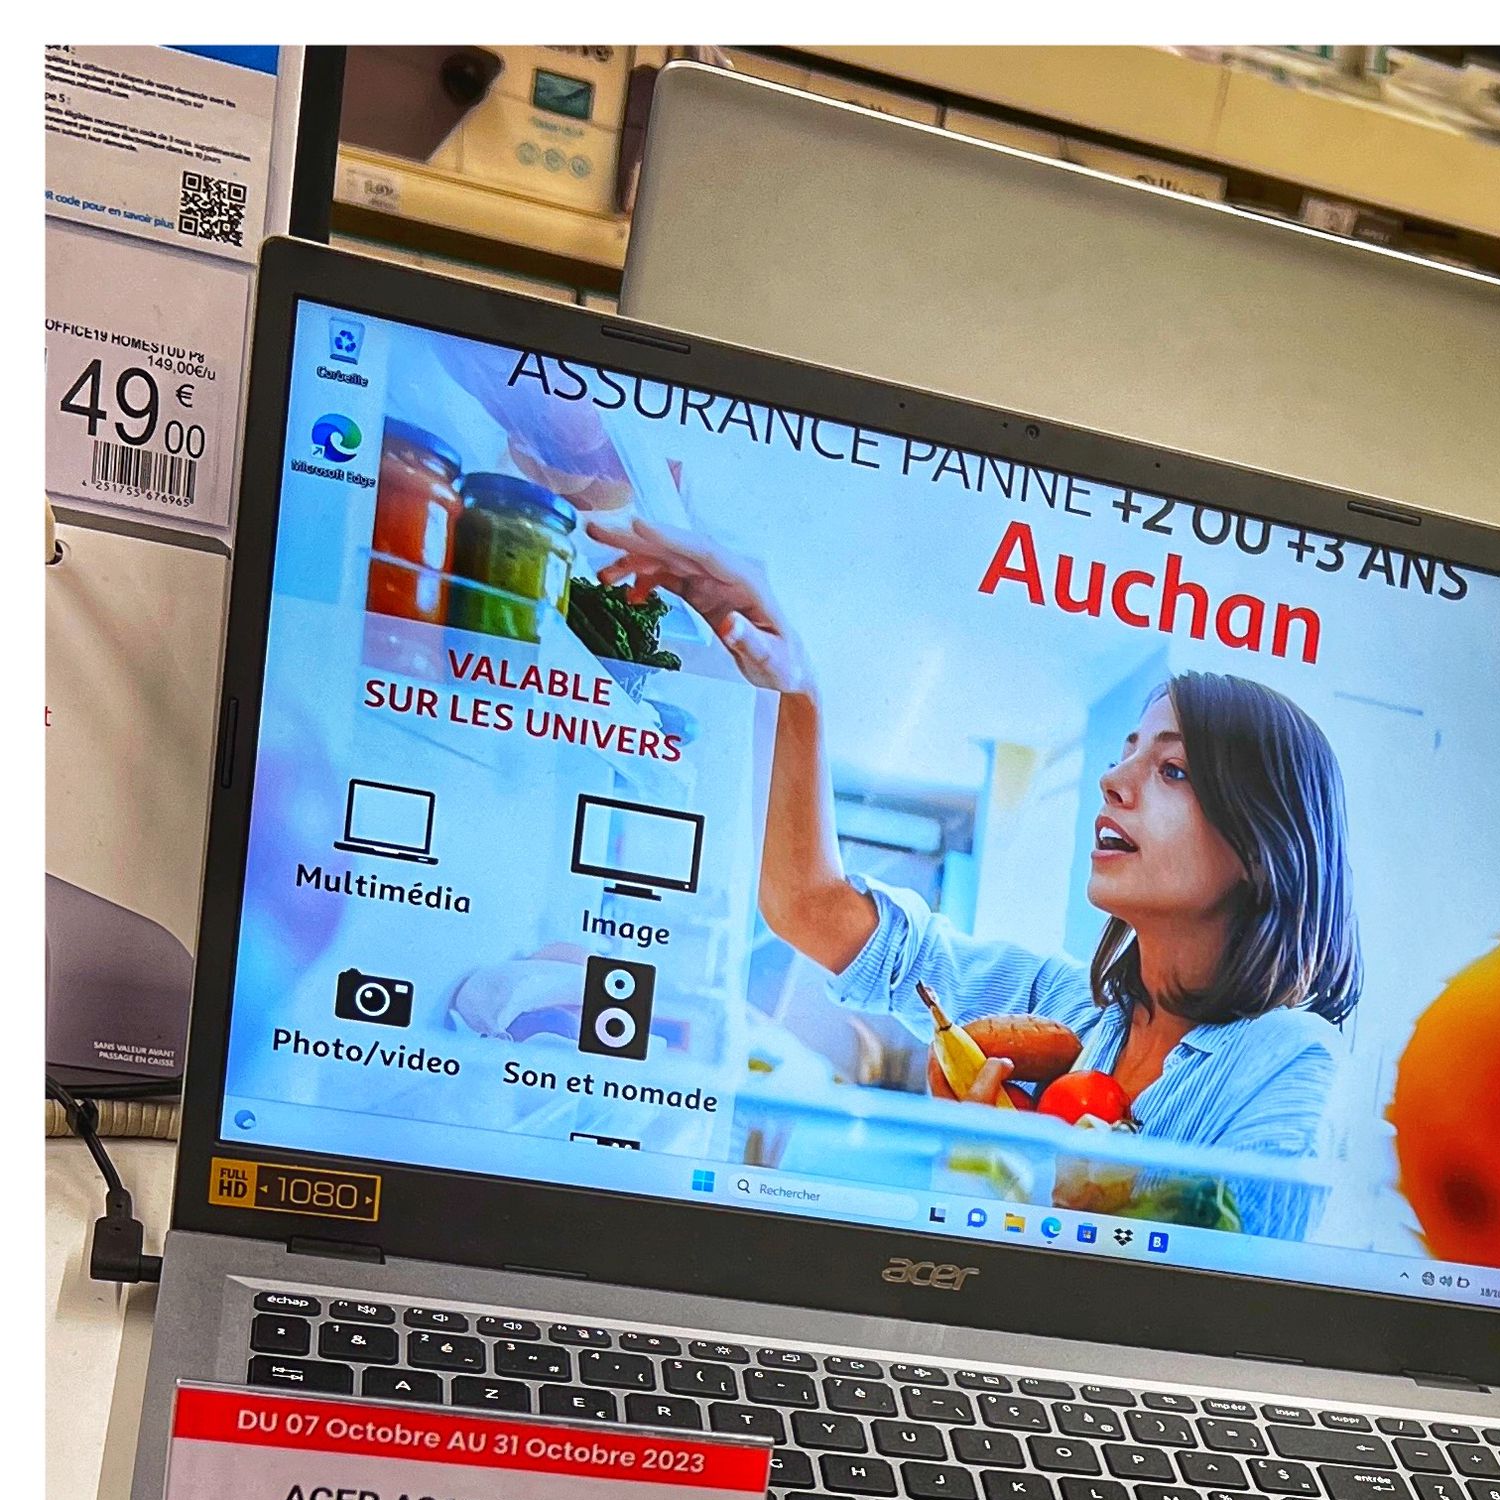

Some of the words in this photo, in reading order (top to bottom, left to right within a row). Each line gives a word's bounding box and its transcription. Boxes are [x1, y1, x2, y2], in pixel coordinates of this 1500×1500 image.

[55, 192, 81, 208] code
[82, 197, 106, 215] pour
[108, 205, 121, 217] en
[123, 209, 153, 224] savoir
[154, 216, 175, 230] plus
[147, 354, 216, 381] 149,00€/u
[316, 364, 369, 388] Corbeille
[164, 419, 206, 459] 00
[290, 456, 344, 484] Microsoft
[346, 469, 377, 491] Edge
[507, 349, 880, 468] ASSURANCE
[902, 438, 1093, 518] PANNE
[1111, 488, 1175, 536] +2
[1191, 505, 1272, 556] OU
[1287, 526, 1346, 573] +3
[1357, 543, 1469, 602] ANS
[978, 519, 1324, 666] Auchan
[448, 648, 613, 708] VALABLE
[363, 678, 438, 720] SUR
[449, 694, 513, 733] LES
[526, 709, 683, 763] UNIVERS
[294, 862, 473, 915] Multimédia
[581, 909, 671, 948] Image
[94, 1040, 115, 1051] SANS
[116, 1043, 147, 1055] VALEUR
[148, 1047, 175, 1058] AVANT
[99, 1050, 134, 1063] PASSAGE
[135, 1055, 147, 1064] EN
[147, 1056, 175, 1067] CAISSE
[272, 1027, 461, 1077] Photo/video
[502, 1060, 557, 1093] Son
[566, 1071, 597, 1096] et
[603, 1079, 718, 1114] nomade
[217, 1178, 249, 1200] HD
[276, 1174, 359, 1212] 1080
[218, 1166, 249, 1184] FULL
[758, 1183, 822, 1203] Rechercher
[881, 1256, 981, 1292] acer
[266, 1293, 310, 1310] échap
[237, 1408, 279, 1433] DU
[284, 1413, 315, 1437] 07
[325, 1416, 441, 1451] Octobre
[446, 1429, 486, 1454] AU
[492, 1433, 519, 1456] 31
[524, 1436, 636, 1470] Octobre
[640, 1447, 706, 1475] 2023
